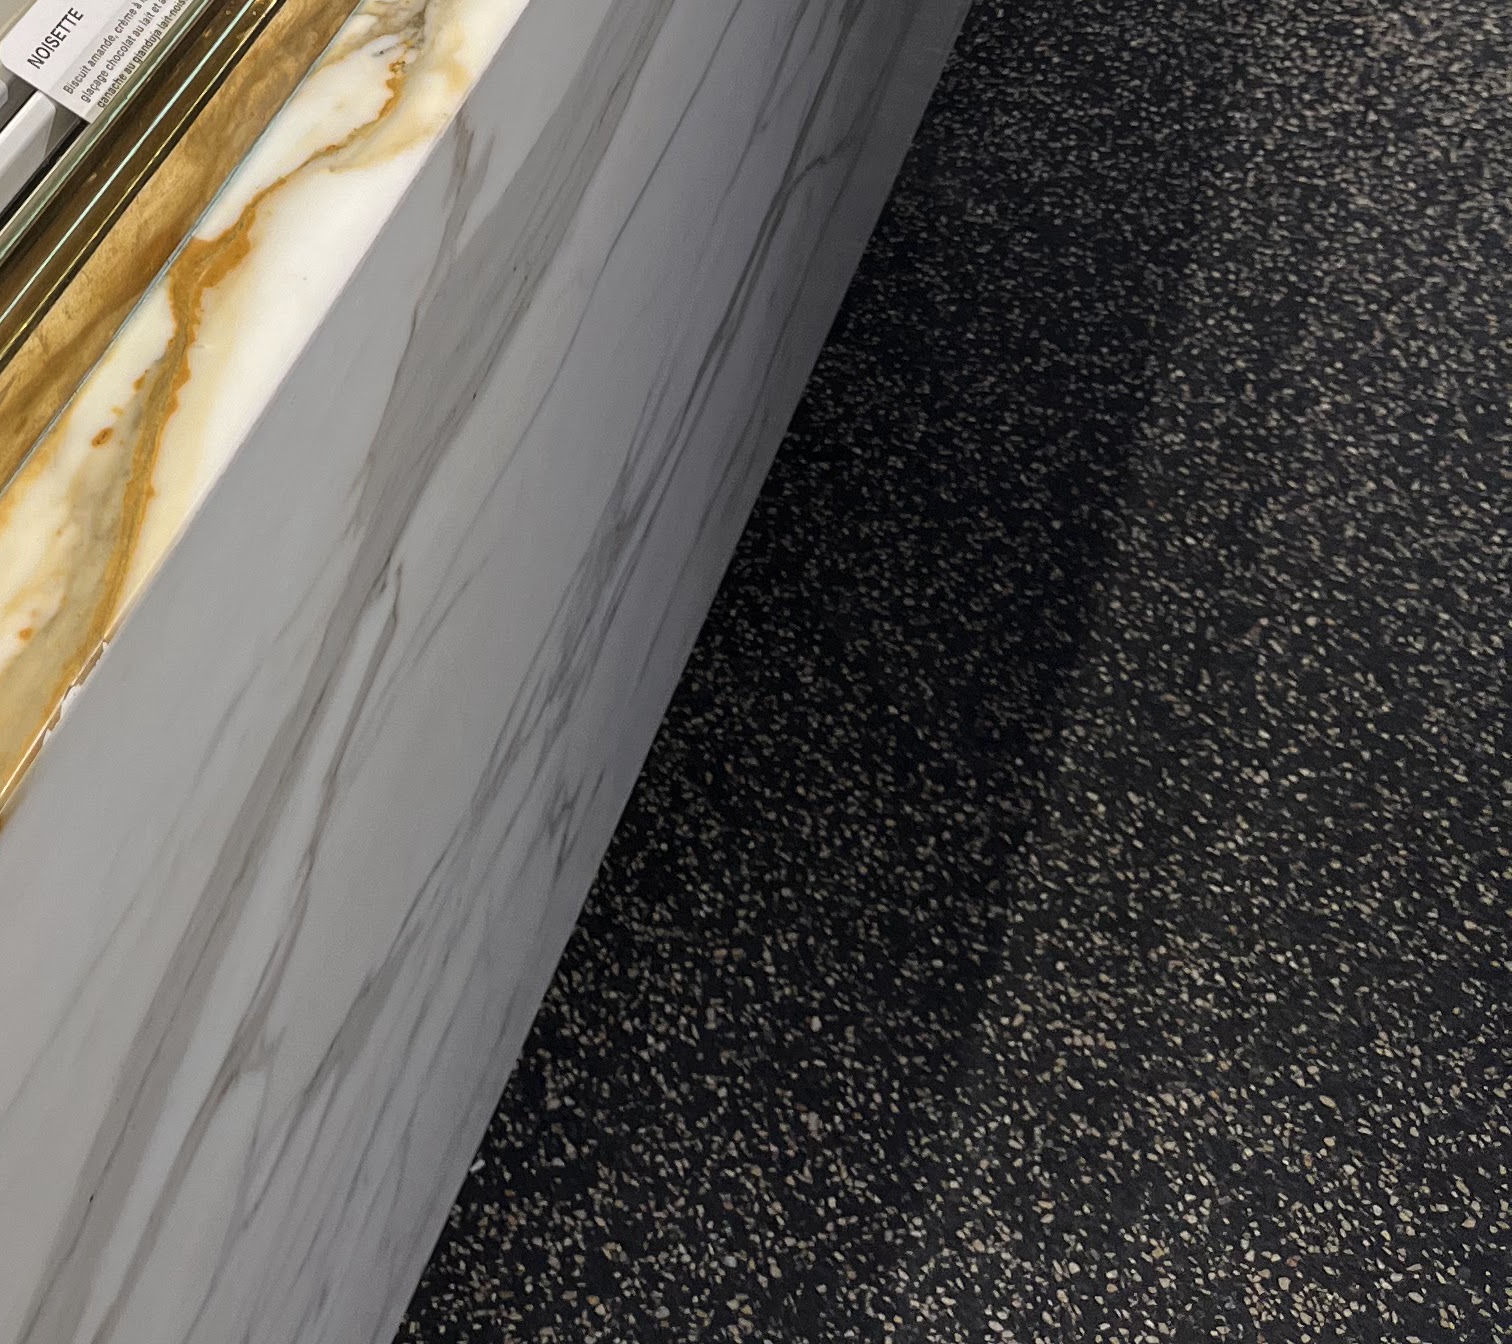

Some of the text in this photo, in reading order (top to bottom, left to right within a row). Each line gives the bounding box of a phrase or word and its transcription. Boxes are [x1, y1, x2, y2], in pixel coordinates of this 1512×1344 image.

[26, 7, 84, 70] NOISETTE
[62, 65, 92, 95] Biscuit
[87, 34, 120, 68] amande,
[114, 8, 138, 34] crème
[131, 2, 143, 10] à
[80, 70, 109, 104] glaçage
[105, 35, 137, 71] chocolat
[132, 24, 145, 38] au
[141, 10, 155, 28] lait
[151, 2, 163, 14] et
[123, 62, 136, 75] au
